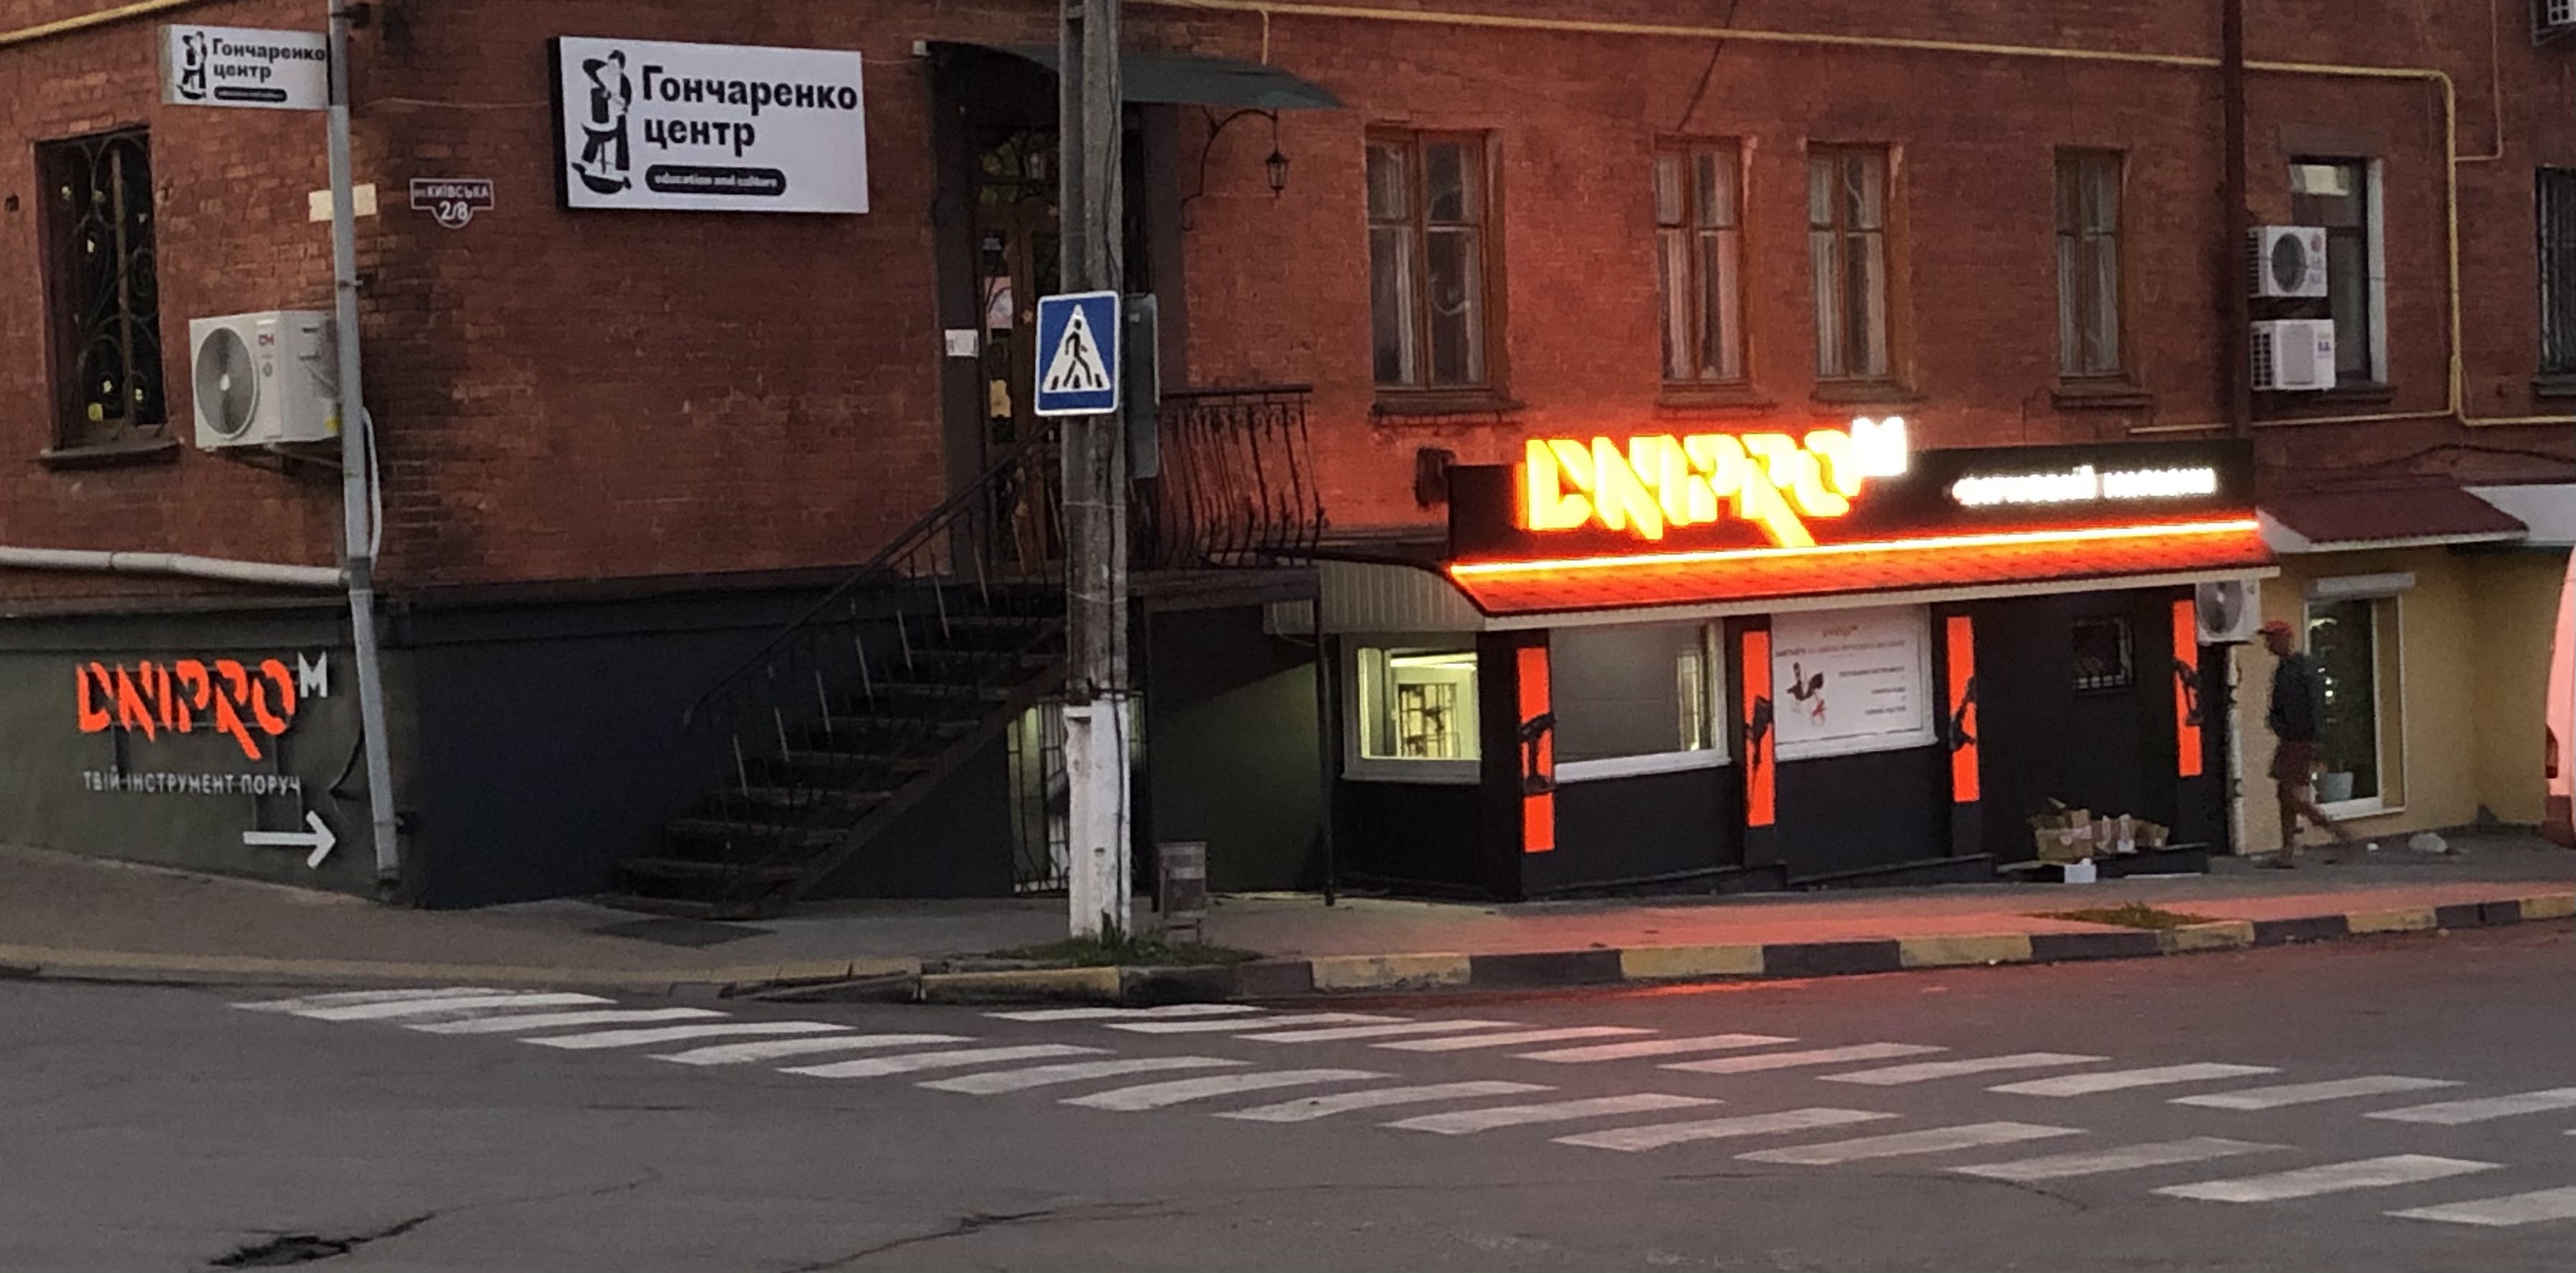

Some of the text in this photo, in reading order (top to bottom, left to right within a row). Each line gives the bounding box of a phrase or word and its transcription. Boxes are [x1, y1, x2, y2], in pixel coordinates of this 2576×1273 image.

[213, 63, 272, 83] центр
[642, 65, 858, 116] Гончаренко
[644, 118, 755, 157] центр
[427, 184, 489, 199] КИЇВСЬКА
[439, 200, 468, 220] 2/8
[1514, 428, 1864, 547] DNIPRO
[76, 658, 296, 760] DNIPRO
[83, 765, 302, 798] ТВІЙ ІНСТРУМЕНТ ПОРУЧ
